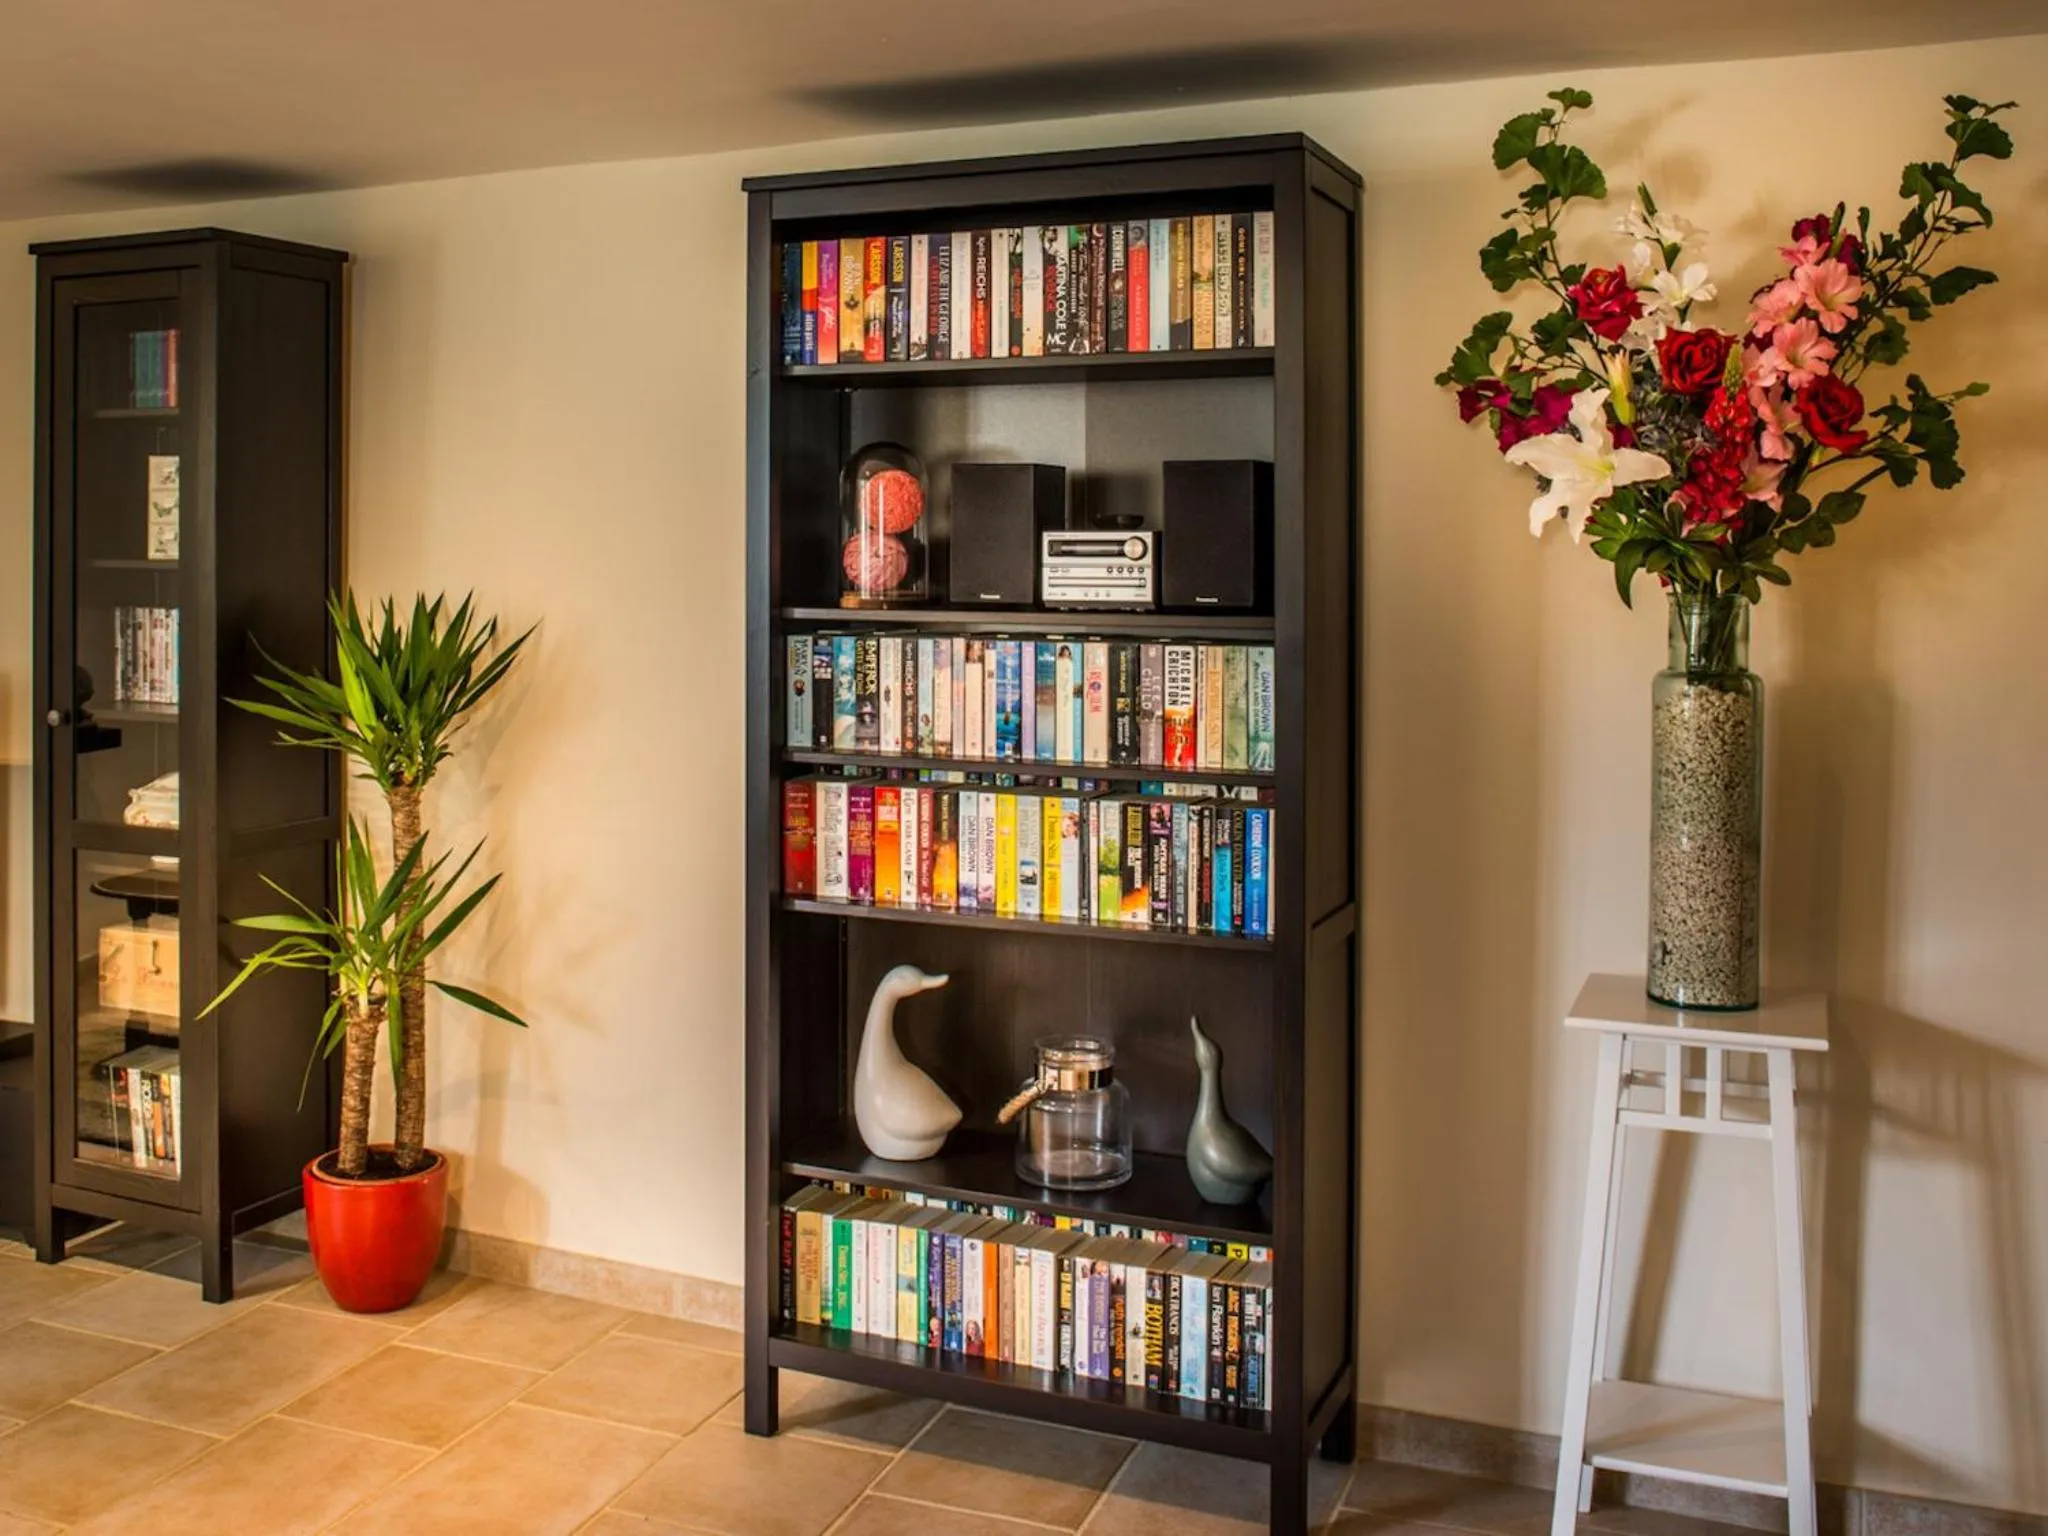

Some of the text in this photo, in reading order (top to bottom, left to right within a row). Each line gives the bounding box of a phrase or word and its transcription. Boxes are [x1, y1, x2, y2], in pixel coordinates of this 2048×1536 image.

[893, 240, 904, 282] LARSSON
[1111, 227, 1125, 273] CORNWELL
[939, 246, 950, 344] ELIZABETH GEORGE
[976, 257, 986, 298] REICHS
[1056, 251, 1067, 330] MARTINA COLE
[1047, 332, 1067, 345] MC
[800, 639, 809, 665] MARY
[865, 639, 877, 695] EMPEROR
[904, 660, 914, 696] REICHS
[1142, 668, 1152, 710] CHILD
[1152, 675, 1161, 703] LEE
[1168, 650, 1179, 707] CRICHTON
[1180, 650, 1191, 707] MICHAEL
[1261, 671, 1272, 733] DAN BROWN
[968, 815, 976, 872] DAN BROWN
[985, 817, 994, 874] DAN BROWN
[1233, 810, 1243, 840] COLIN
[1233, 842, 1243, 880] DEXTER
[1170, 1276, 1180, 1297] DICK
[1170, 1298, 1180, 1335] FRANCIS
[1211, 1286, 1223, 1346] Ian Rankin
[1245, 1293, 1256, 1326] WHITE
[1145, 1303, 1163, 1366] BOTHAM
